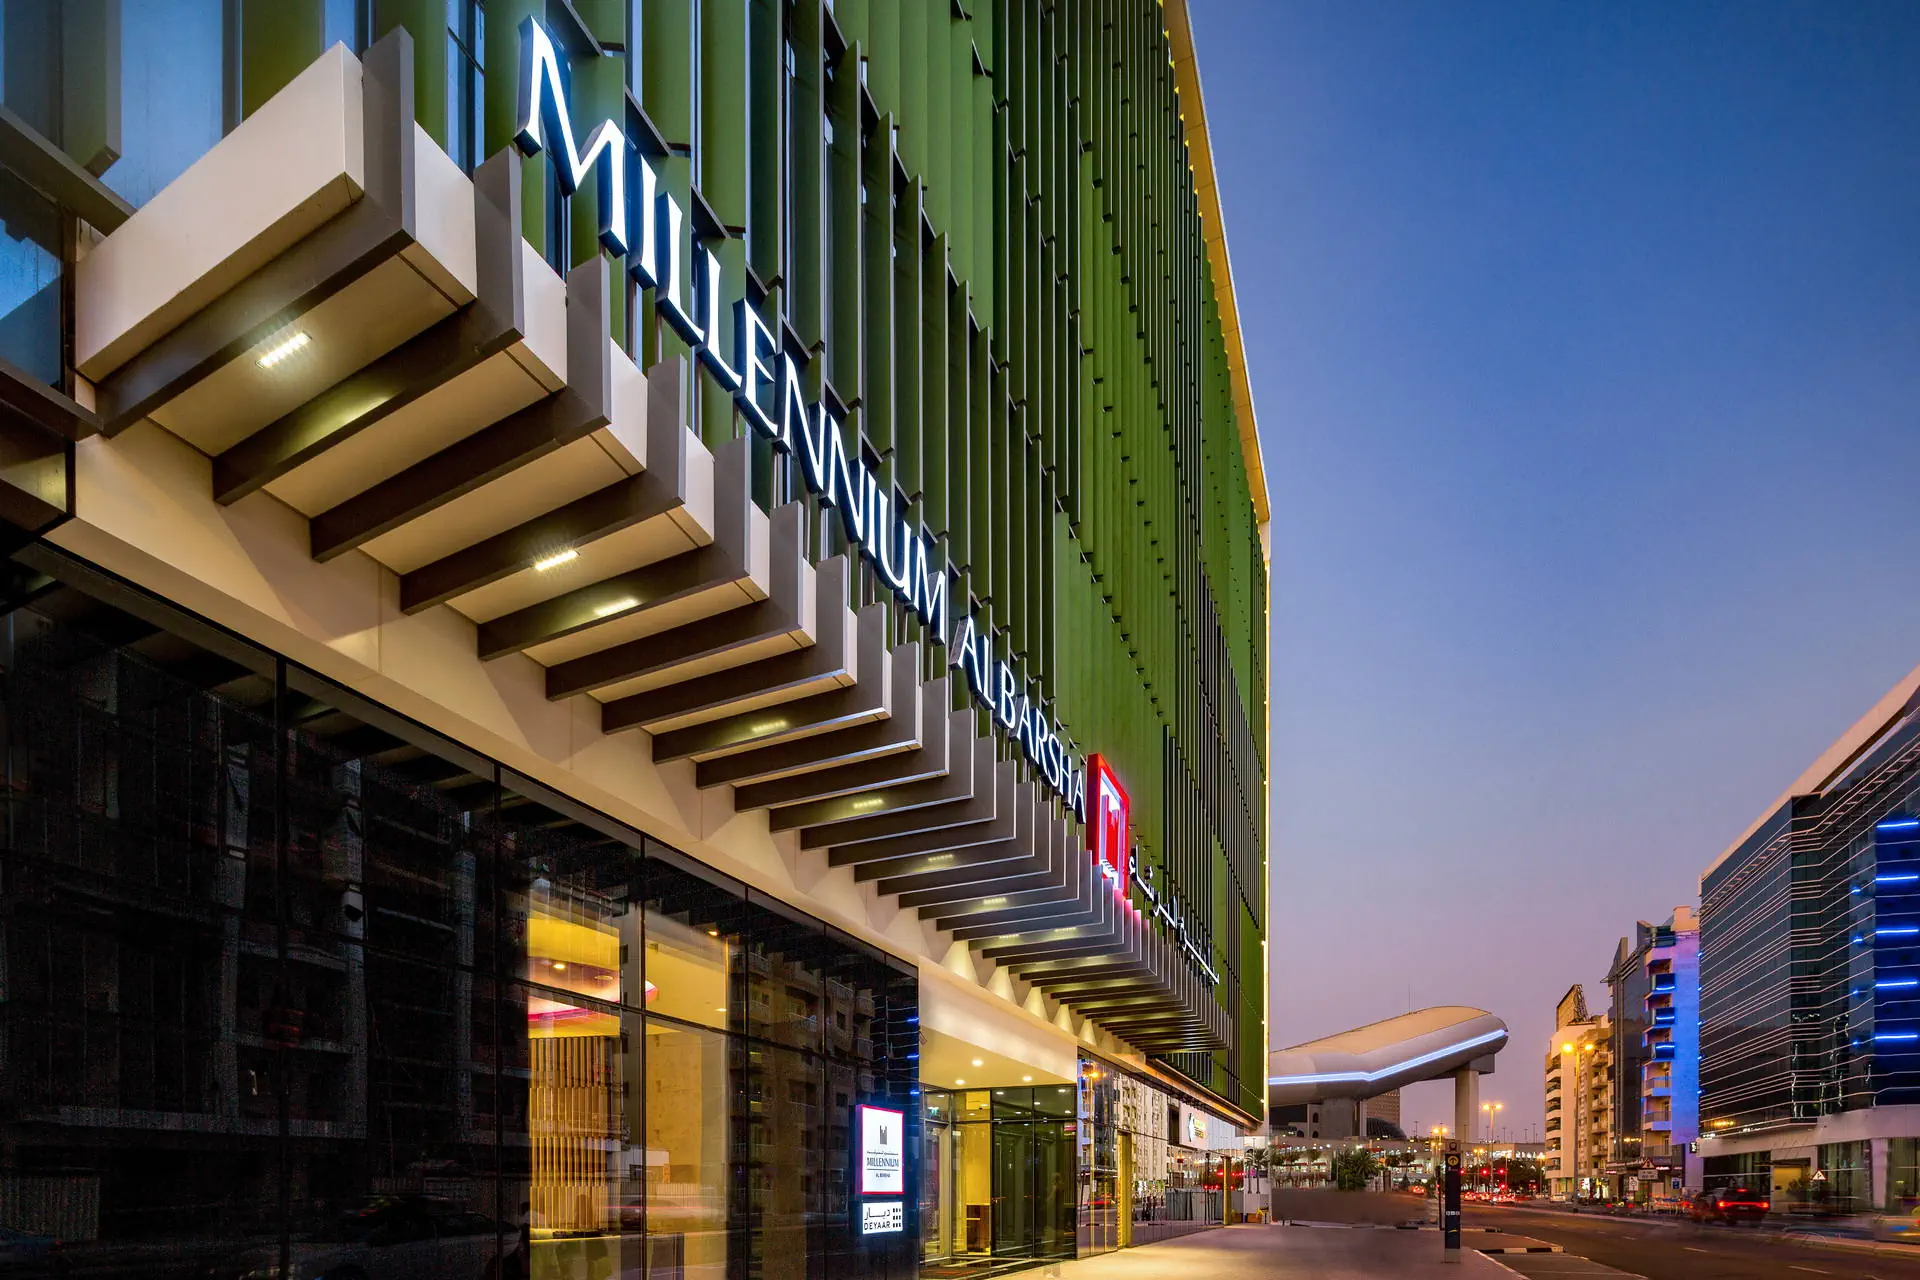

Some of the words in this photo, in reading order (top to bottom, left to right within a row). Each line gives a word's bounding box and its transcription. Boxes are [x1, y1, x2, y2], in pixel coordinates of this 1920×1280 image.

[515, 15, 946, 645] MILLENNIUM
[995, 660, 1086, 824] BARSHA
[864, 1207, 891, 1220] ديار
[864, 1221, 891, 1231] DEYAAR
